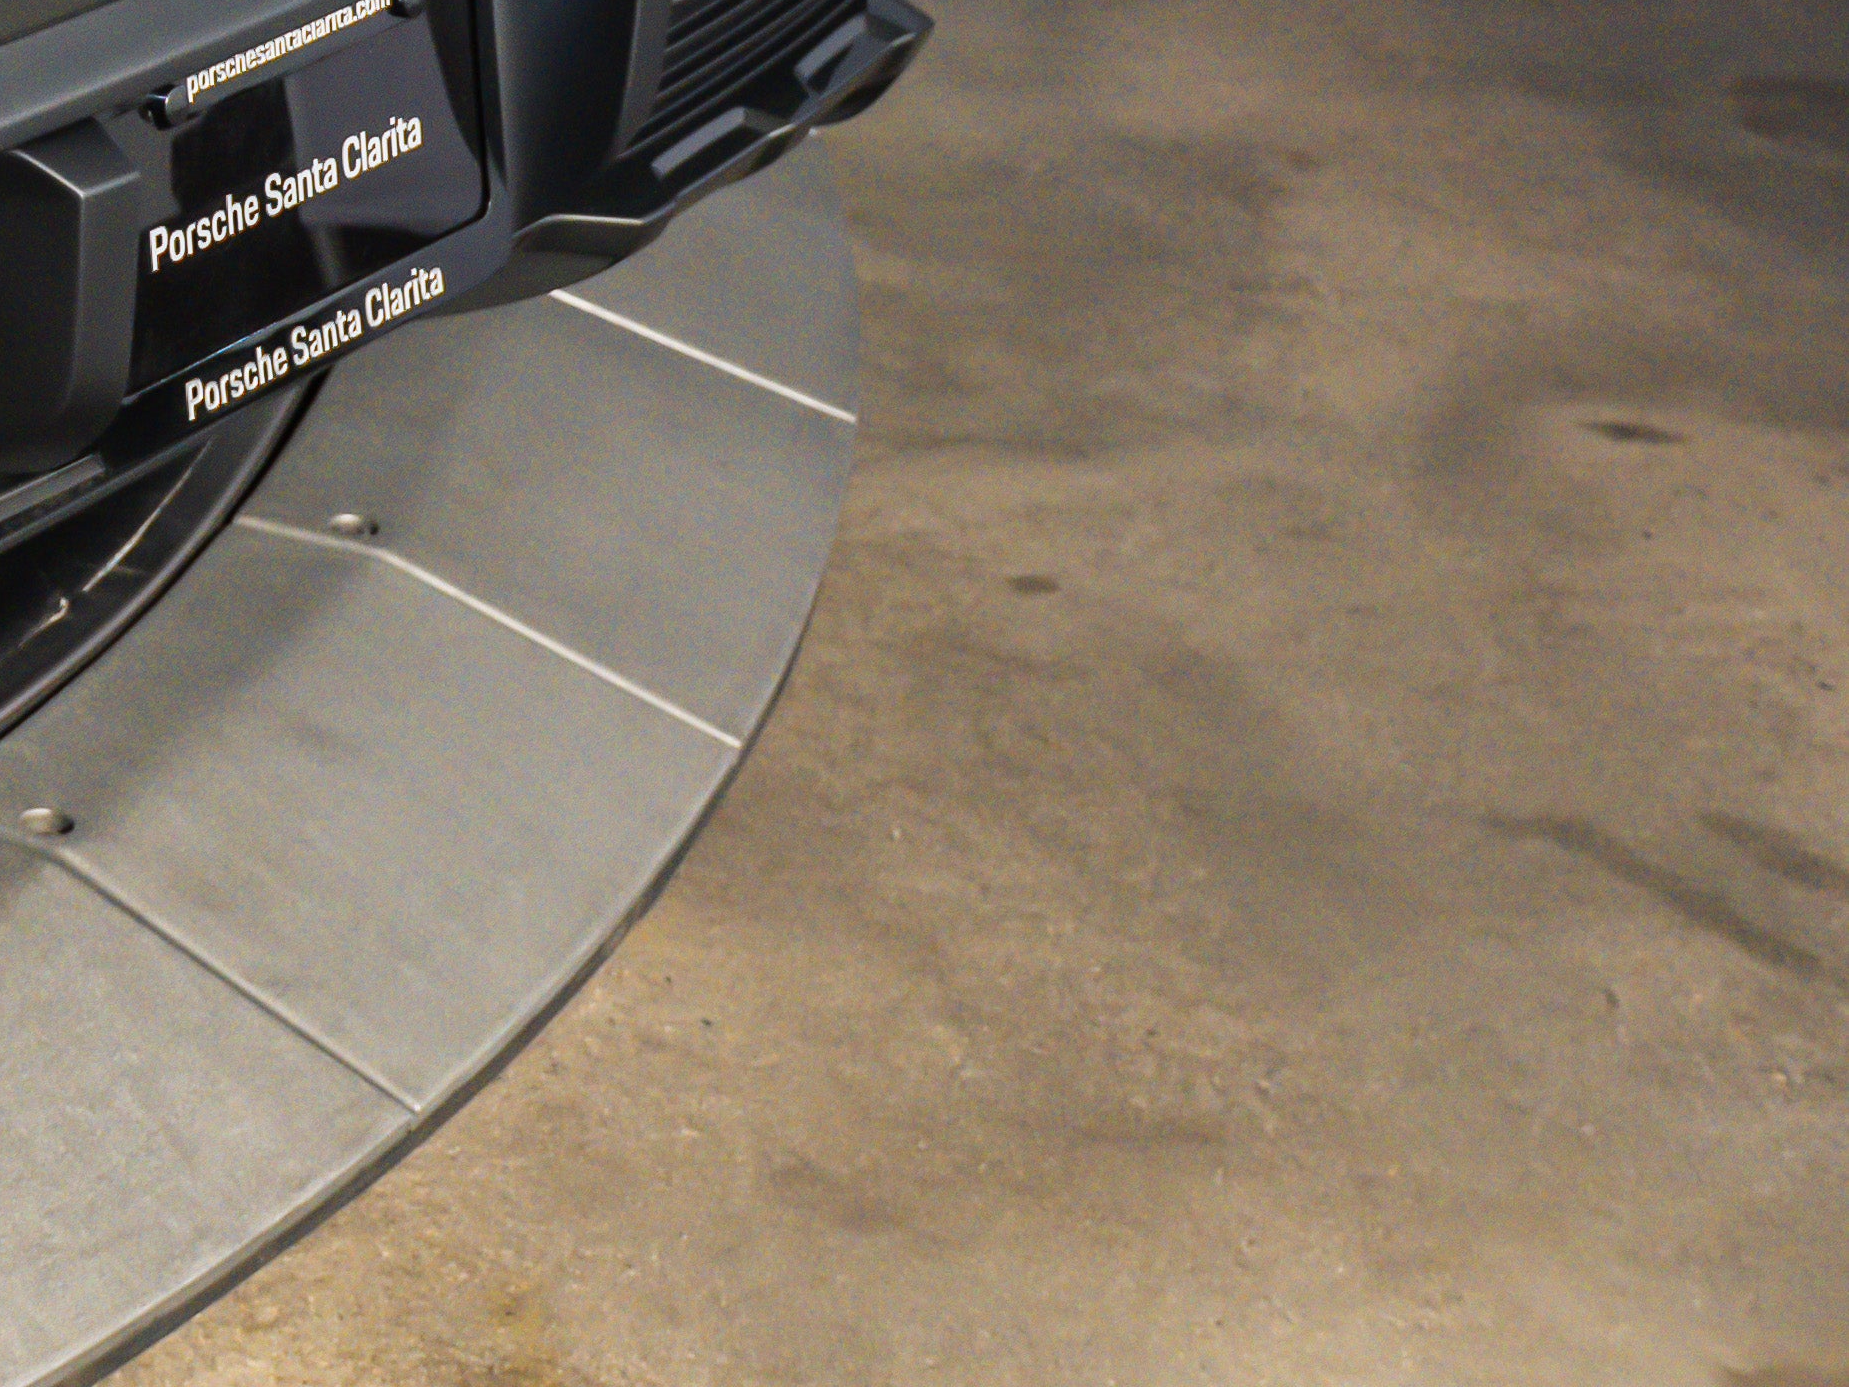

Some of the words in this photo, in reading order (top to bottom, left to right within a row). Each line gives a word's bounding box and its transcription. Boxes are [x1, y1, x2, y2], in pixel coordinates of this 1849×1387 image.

[149, 193, 260, 273] Porsche
[264, 158, 339, 218] Santa
[341, 115, 423, 179] Clarita
[185, 345, 289, 422] Porsche
[289, 308, 363, 367] Santa
[364, 266, 446, 329] Clarita
